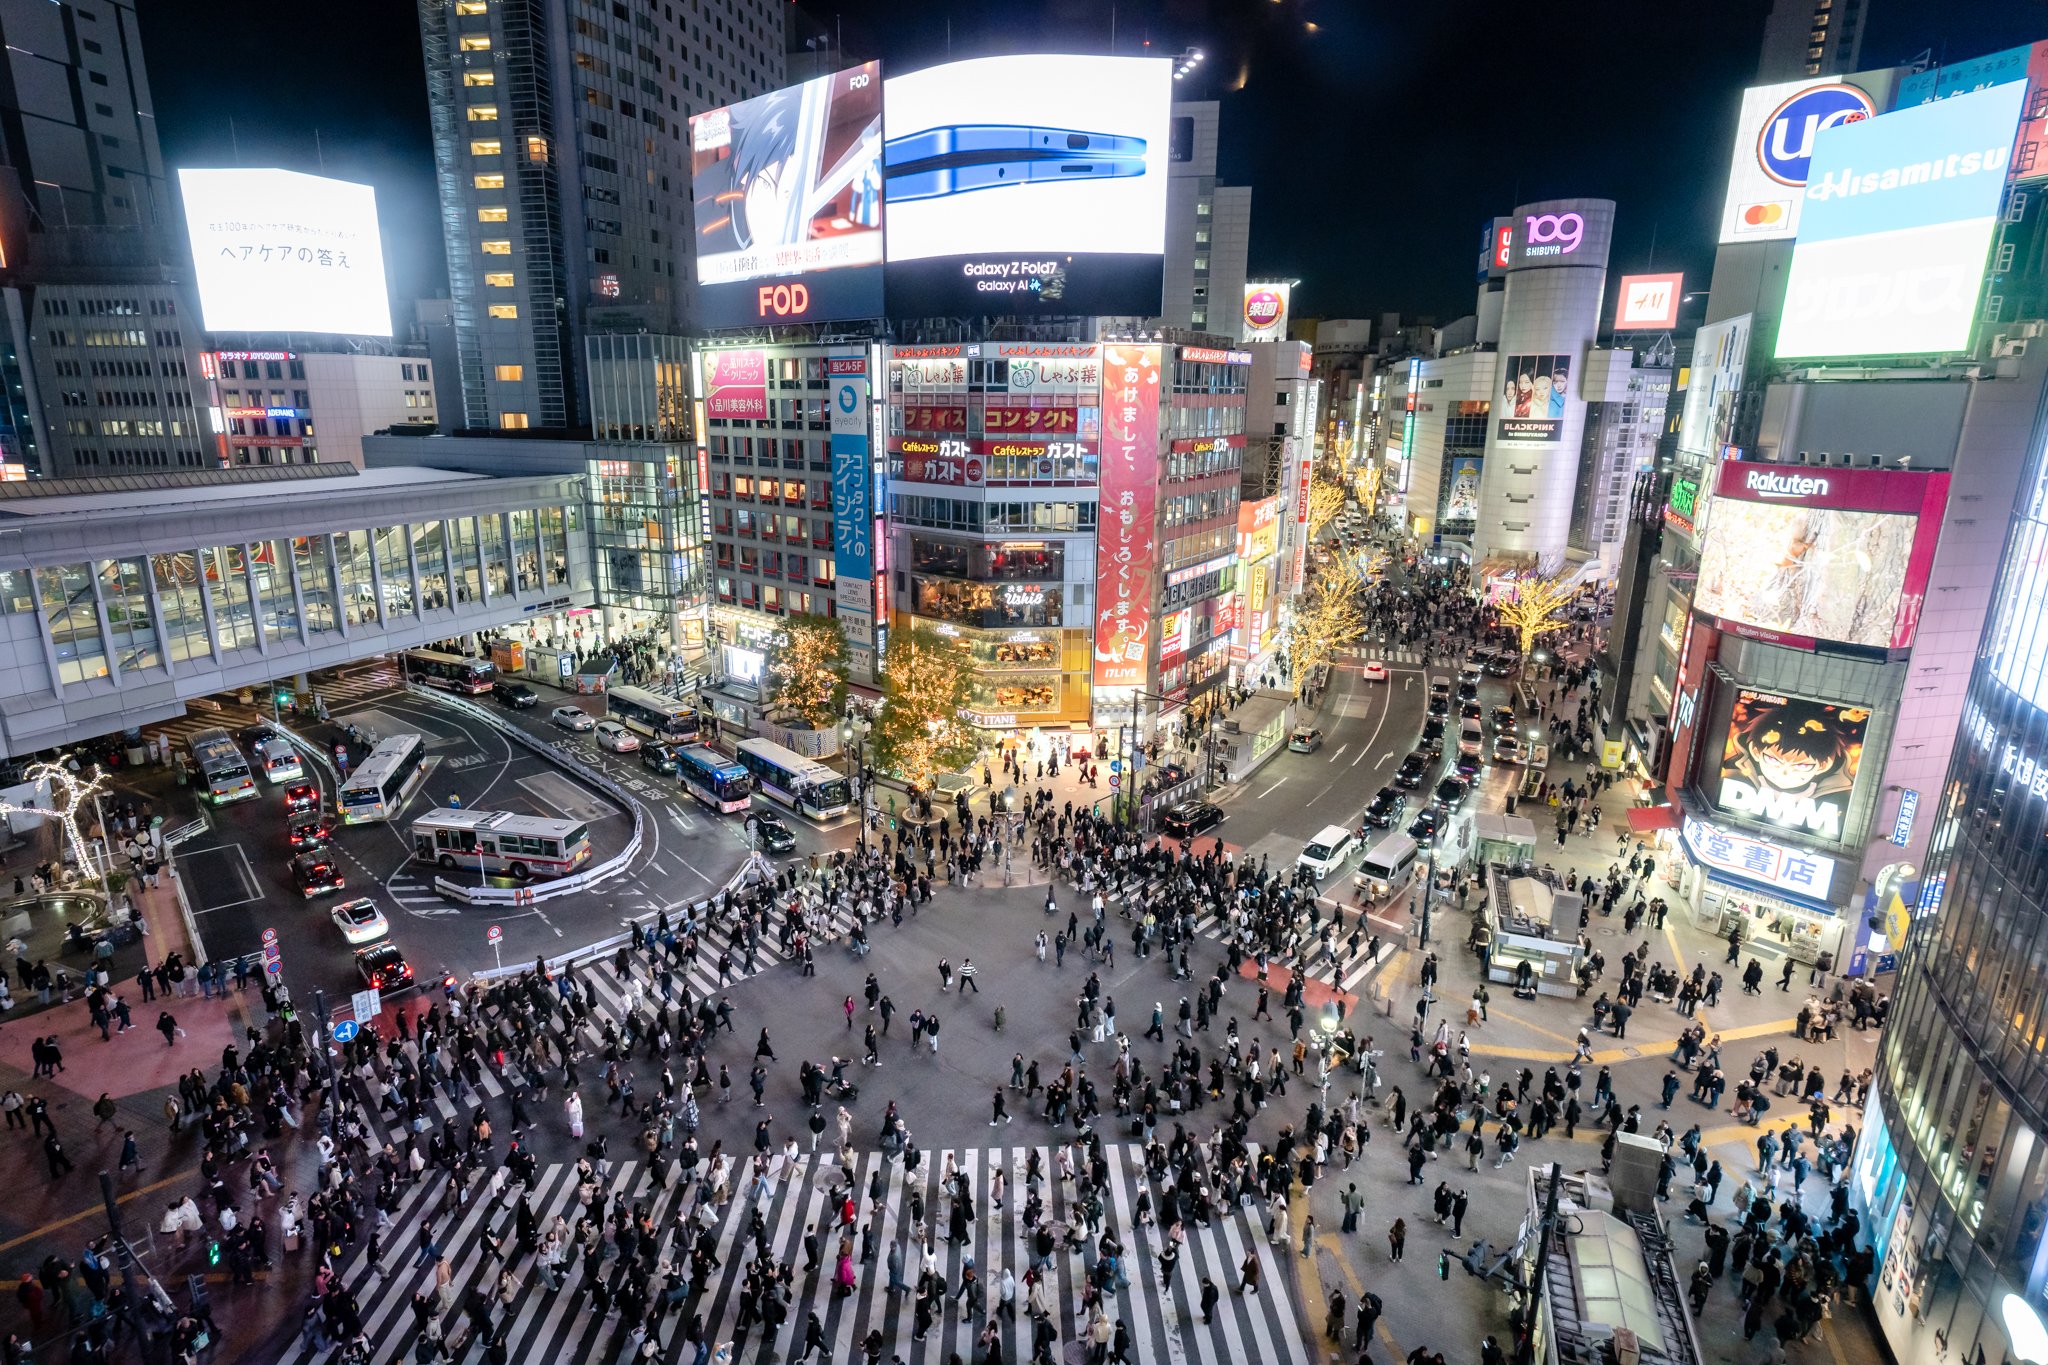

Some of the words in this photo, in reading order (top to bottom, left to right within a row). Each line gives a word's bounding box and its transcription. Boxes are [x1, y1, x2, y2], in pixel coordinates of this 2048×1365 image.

[850, 74, 869, 90] FOD
[1806, 146, 2007, 201] Hisamitsu
[1526, 213, 1584, 254] 109
[221, 244, 350, 269] ヘアケアの答え
[1526, 245, 1560, 257] SHIBUYA
[964, 263, 1010, 277] Galaxy
[1011, 262, 1019, 274] Z
[1022, 262, 1057, 274] Fold7
[977, 281, 1016, 293] Galaxy
[1017, 281, 1028, 290] AI
[759, 283, 808, 316] FOD
[220, 352, 248, 360] カラオケ
[250, 352, 284, 360] JOYSOUND
[1000, 345, 1097, 357] しゃぶしゃぶバイキング
[729, 357, 761, 371] 品川スキン
[832, 360, 862, 373] 当ビル5F
[730, 369, 759, 381] クリニック
[890, 370, 901, 382] 9F
[925, 366, 964, 383] しゃぶ葉
[1040, 365, 1097, 383] しゃぶ葉
[268, 409, 294, 417] ADERANS
[715, 398, 764, 413] 品川美容外科
[834, 416, 863, 428] eyecity
[905, 408, 965, 426] プライス
[985, 410, 1075, 428] コンタクト
[1504, 423, 1555, 431] BLACKPINK
[939, 440, 971, 457] ガスト
[1046, 442, 1088, 458] ガスト
[924, 459, 961, 481] ガスト
[1747, 470, 1829, 496] Rakuten
[836, 453, 852, 556] アイシティ
[852, 454, 866, 558] コンタクトの
[1115, 490, 1135, 643] おもしろくします。
[842, 581, 863, 591] CONTACT
[1004, 592, 1044, 605] Ushi8
[1736, 625, 1759, 636] Rakuten
[1718, 777, 1839, 835] DMM
